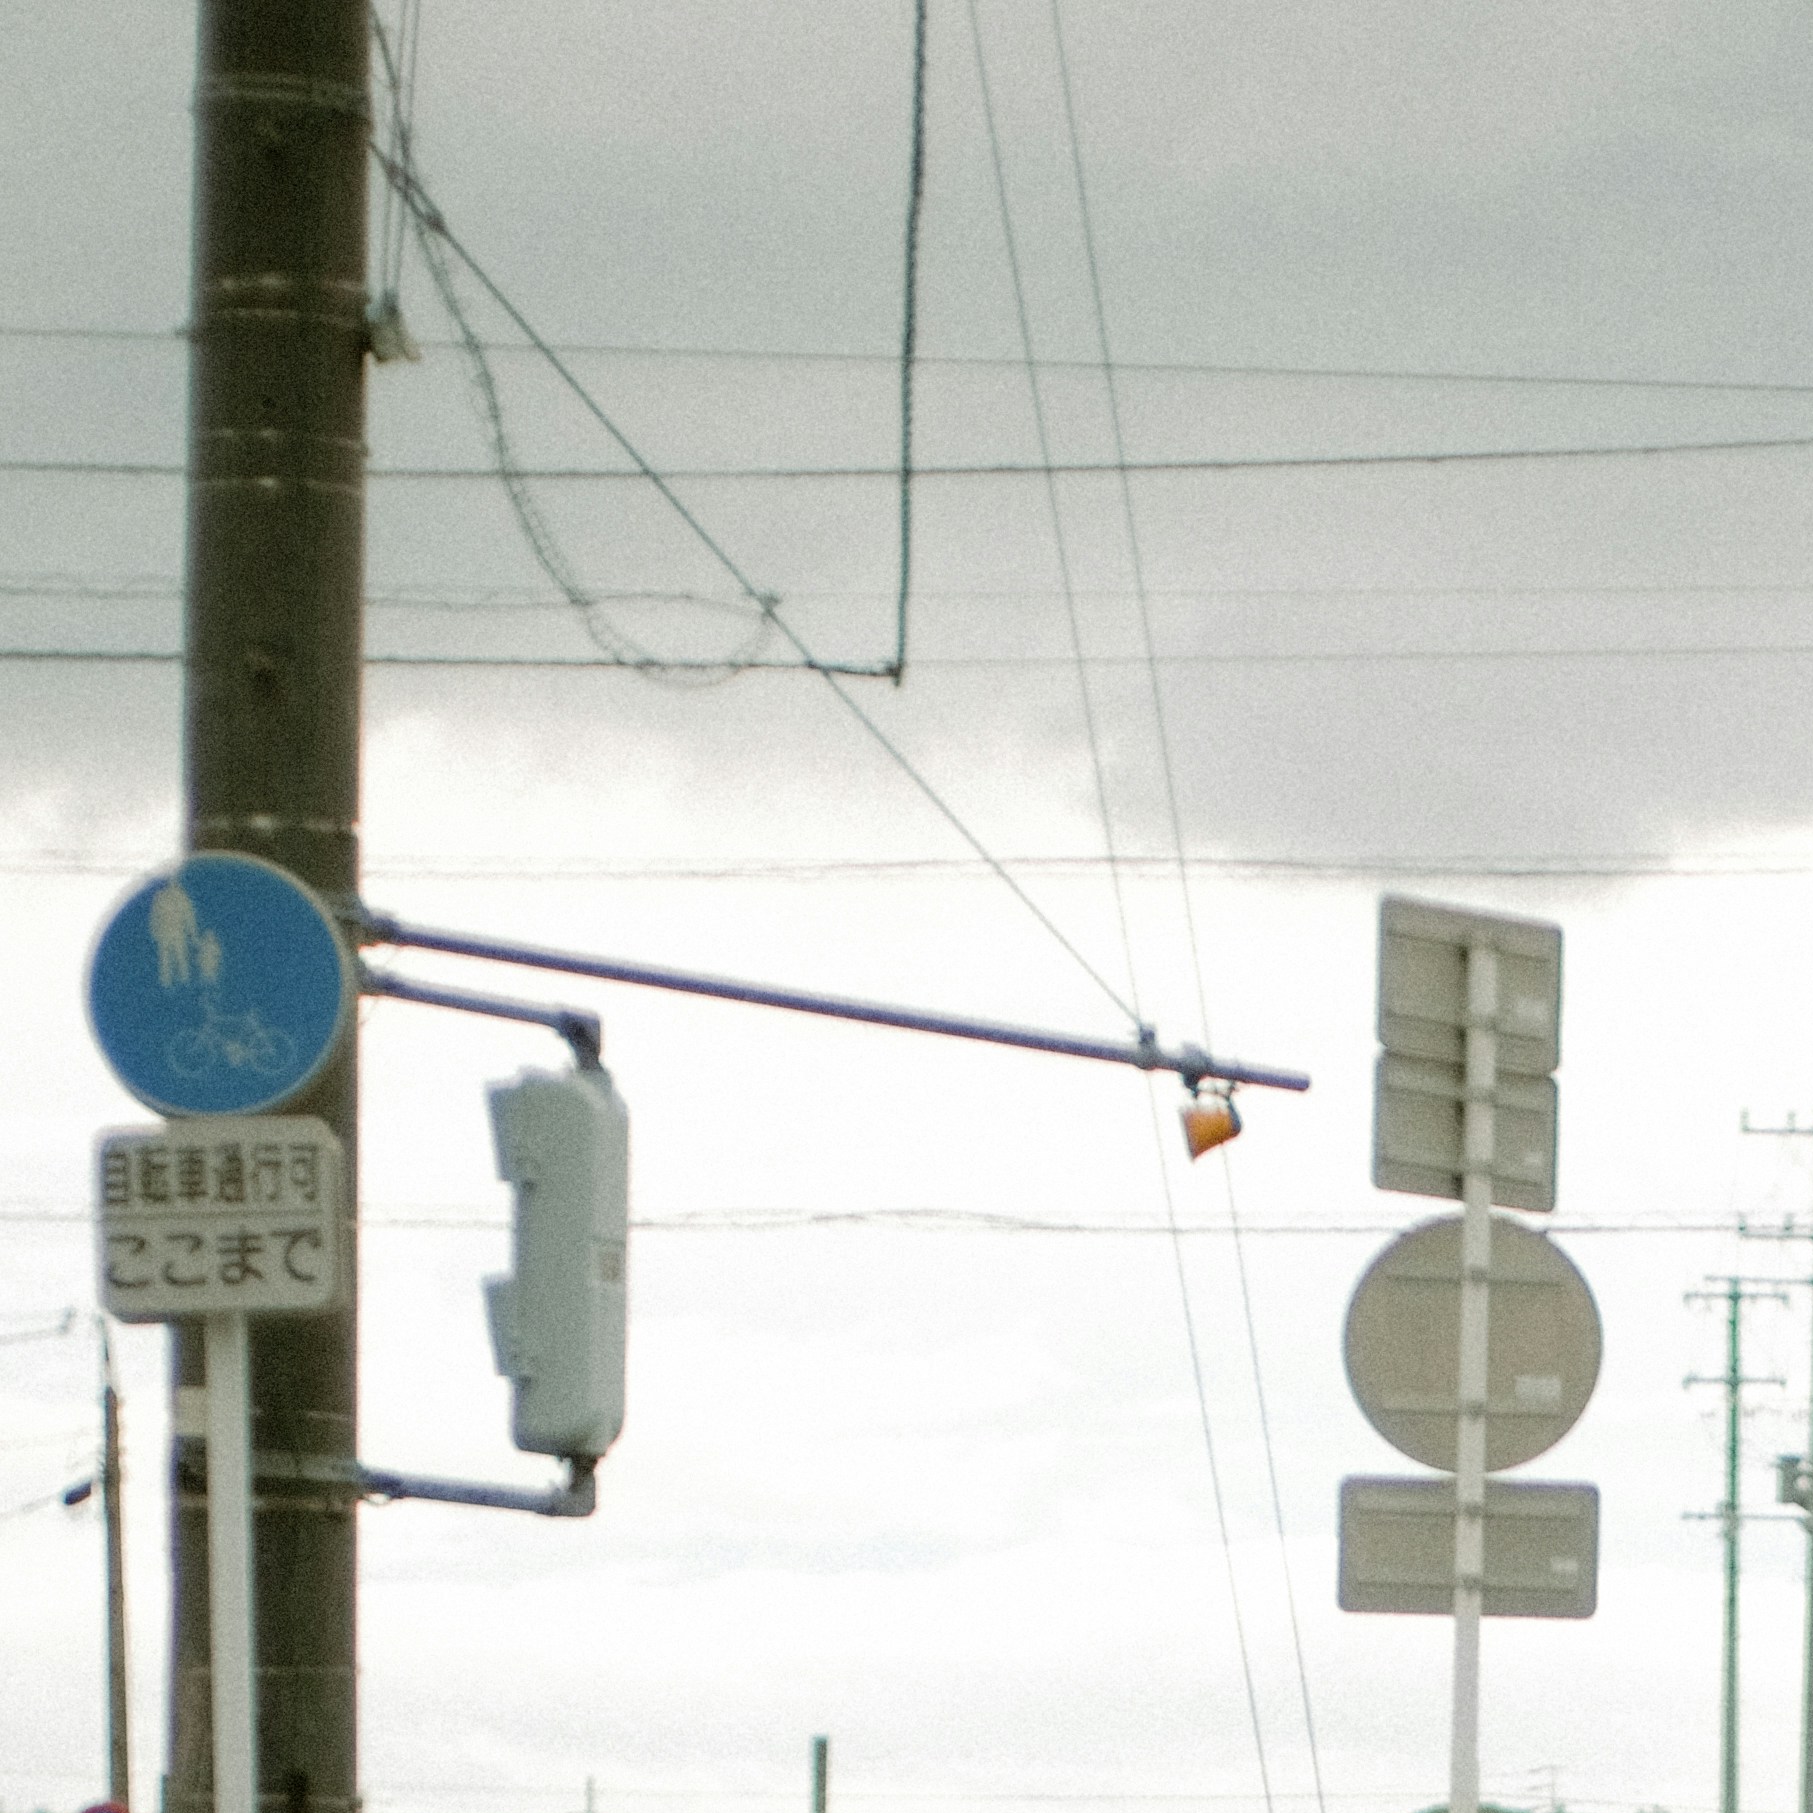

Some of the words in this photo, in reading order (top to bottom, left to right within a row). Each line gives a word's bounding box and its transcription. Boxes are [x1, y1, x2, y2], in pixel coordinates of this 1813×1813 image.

[103, 1142, 320, 1204] 自転車通行可
[105, 1226, 322, 1289] ここまで
